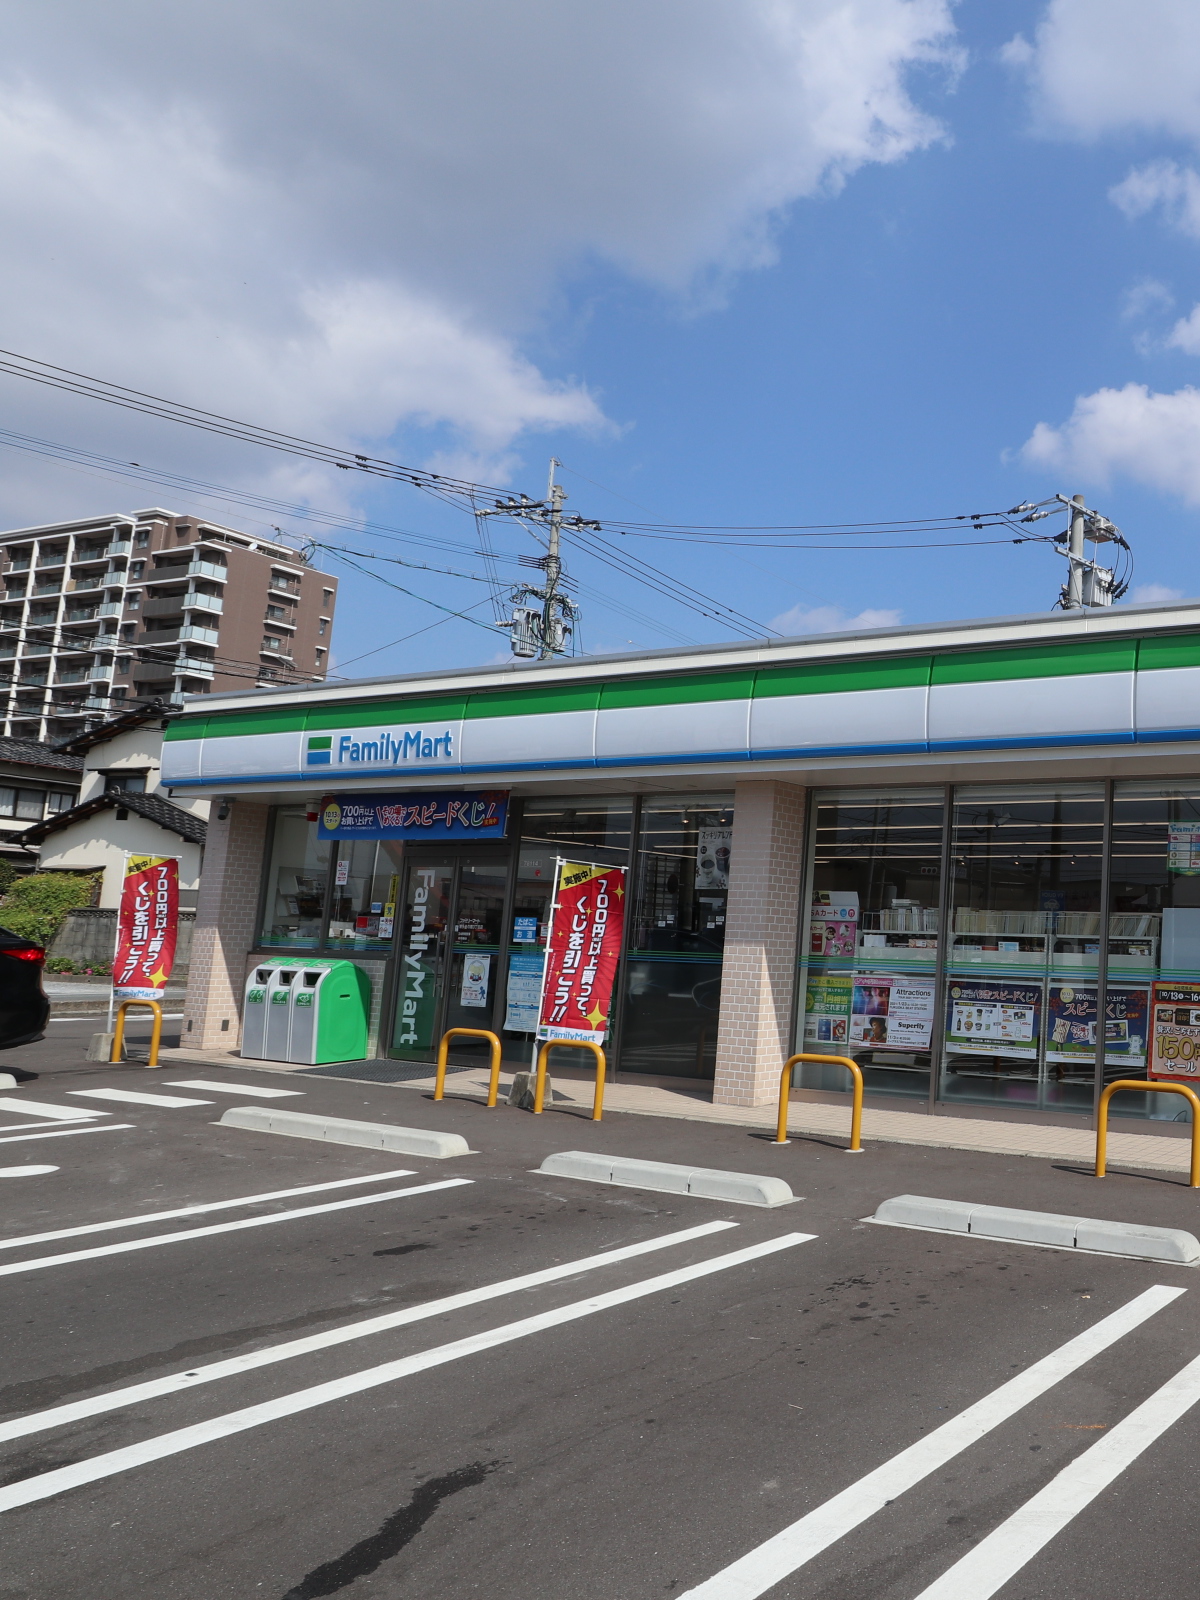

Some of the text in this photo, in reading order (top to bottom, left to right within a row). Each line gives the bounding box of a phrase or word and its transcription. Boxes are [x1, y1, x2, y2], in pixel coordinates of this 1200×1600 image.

[338, 730, 454, 765] FamilyMart
[342, 805, 375, 816] 700円以上
[381, 804, 407, 816] その場で
[341, 816, 374, 826] お買い上げで
[564, 868, 593, 886] 実施中!
[517, 918, 533, 926] たばこ
[400, 869, 436, 1045] FamilyMart
[549, 896, 588, 1023] くじを引こう!!
[119, 990, 157, 998] FamilyMart
[895, 988, 932, 997] Attractions
[1062, 1002, 1127, 1019] スピーくじ
[897, 1022, 925, 1030] Superfly
[549, 1029, 596, 1042] FamilyMart
[1164, 1060, 1196, 1073] セール
